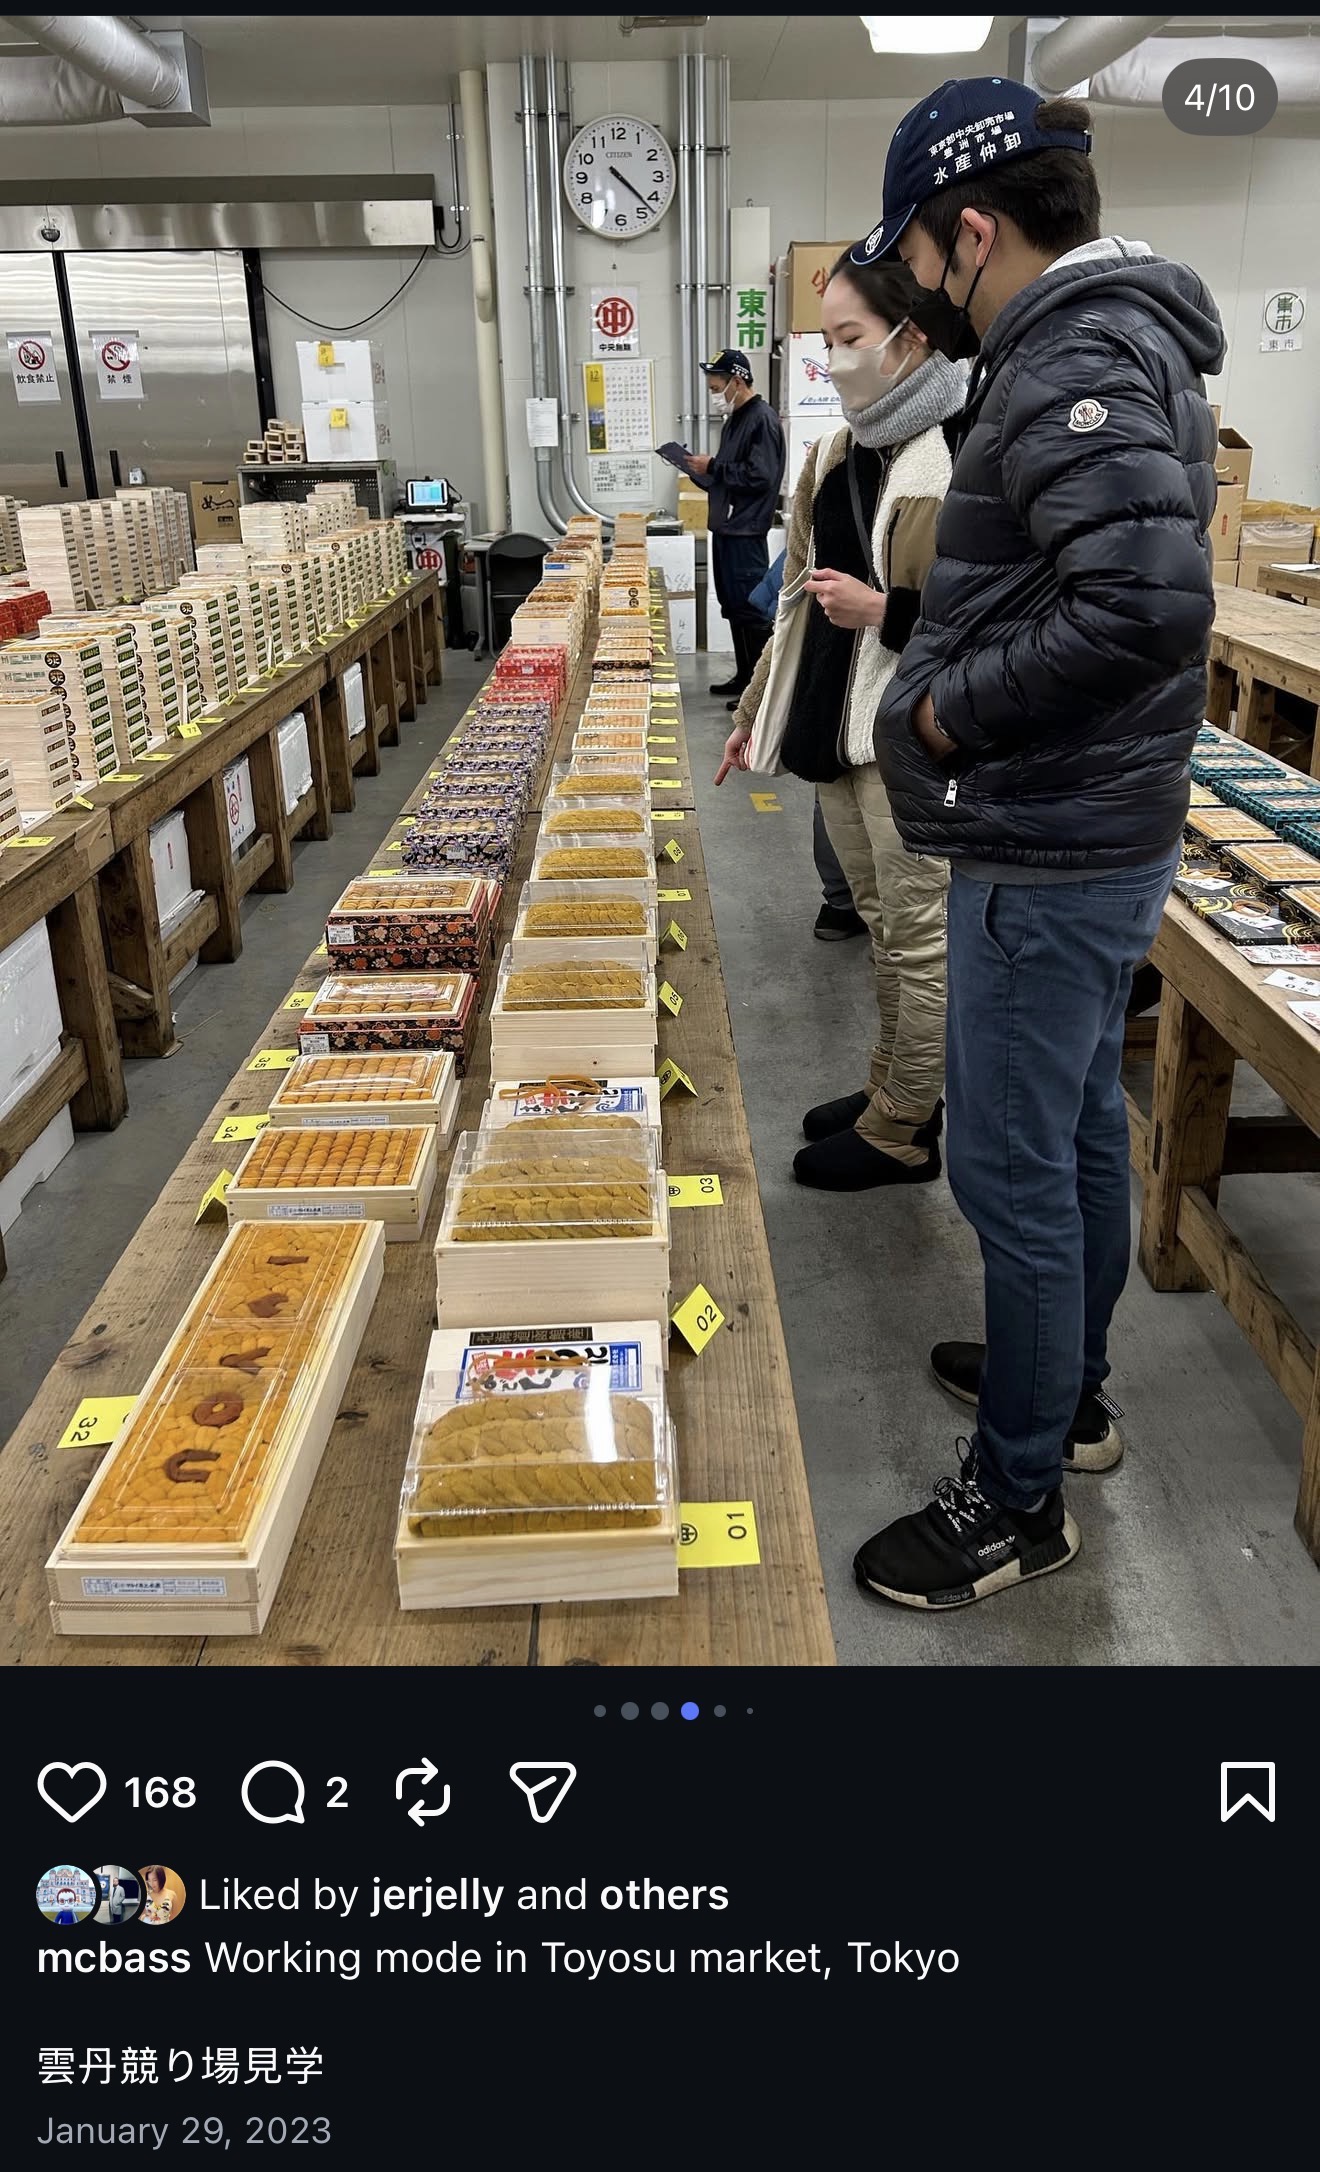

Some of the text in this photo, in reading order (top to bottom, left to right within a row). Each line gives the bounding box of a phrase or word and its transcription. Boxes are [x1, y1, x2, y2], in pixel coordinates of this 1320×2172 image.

[611, 128, 626, 140] 12
[636, 132, 641, 144] 1
[592, 136, 605, 148] 11
[579, 153, 594, 165] 10
[647, 149, 658, 161] 2
[933, 132, 1021, 184] 水産仲卸
[576, 172, 588, 184] 9
[652, 170, 664, 182] 3
[581, 192, 593, 204] 8
[647, 191, 660, 202] 4
[636, 207, 648, 219] 5
[615, 214, 627, 226] 6
[736, 288, 767, 349] 東市
[16, 373, 55, 384] 飲食禁止
[107, 374, 133, 384] 禁煙
[290, 998, 304, 1008] 36
[670, 992, 678, 1006] 05
[254, 1057, 271, 1068] 35
[221, 1126, 239, 1139] 34
[700, 1177, 714, 1194] 03
[696, 1304, 718, 1332] 02
[70, 1416, 98, 1442] 32
[726, 1513, 747, 1540] 01
[978, 1540, 1006, 1557] adidas
